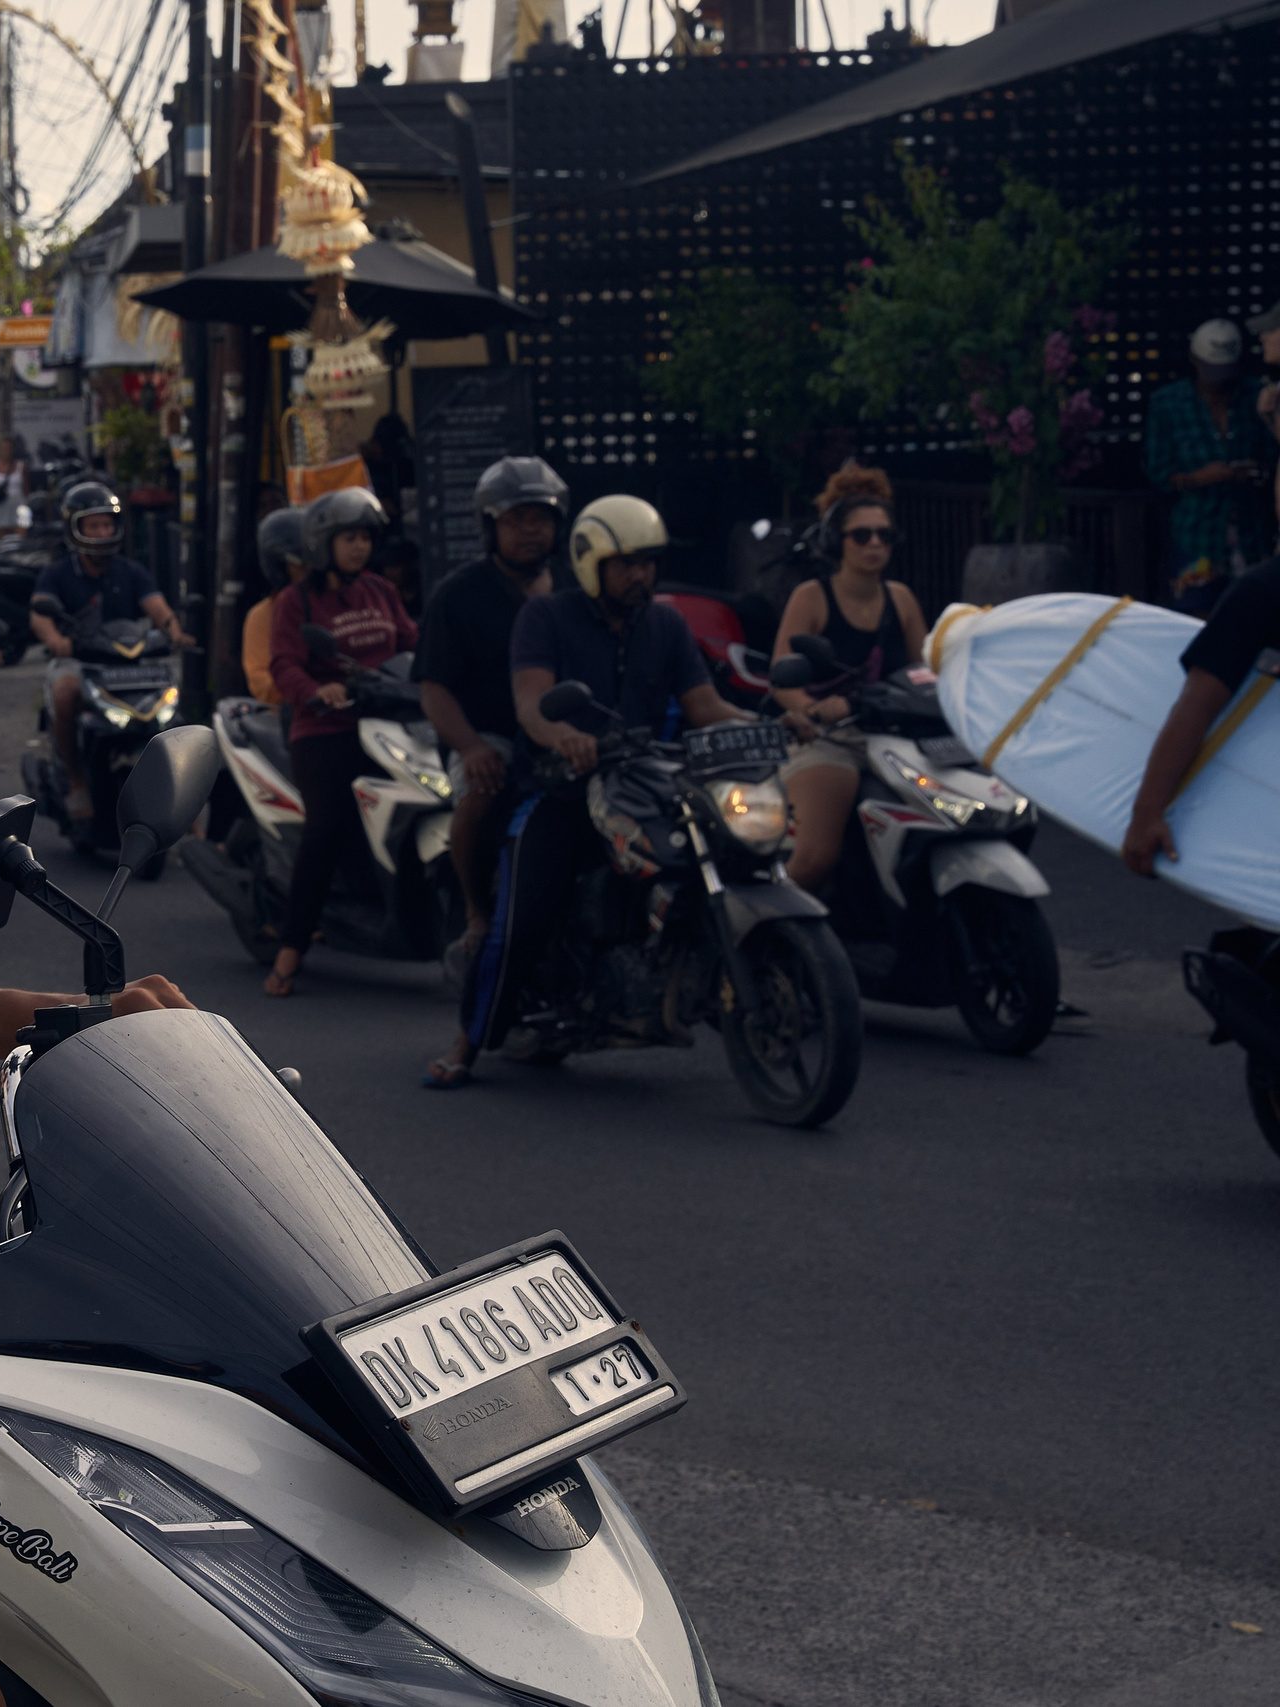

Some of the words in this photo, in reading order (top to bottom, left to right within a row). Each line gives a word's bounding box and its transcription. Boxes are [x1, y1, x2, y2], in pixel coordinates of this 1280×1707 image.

[360, 1336, 440, 1410] DK
[421, 1299, 531, 1379] 4186
[438, 1396, 513, 1436] HONDA
[513, 1476, 581, 1518] HONDA
[16, 1534, 76, 1581] Bali
